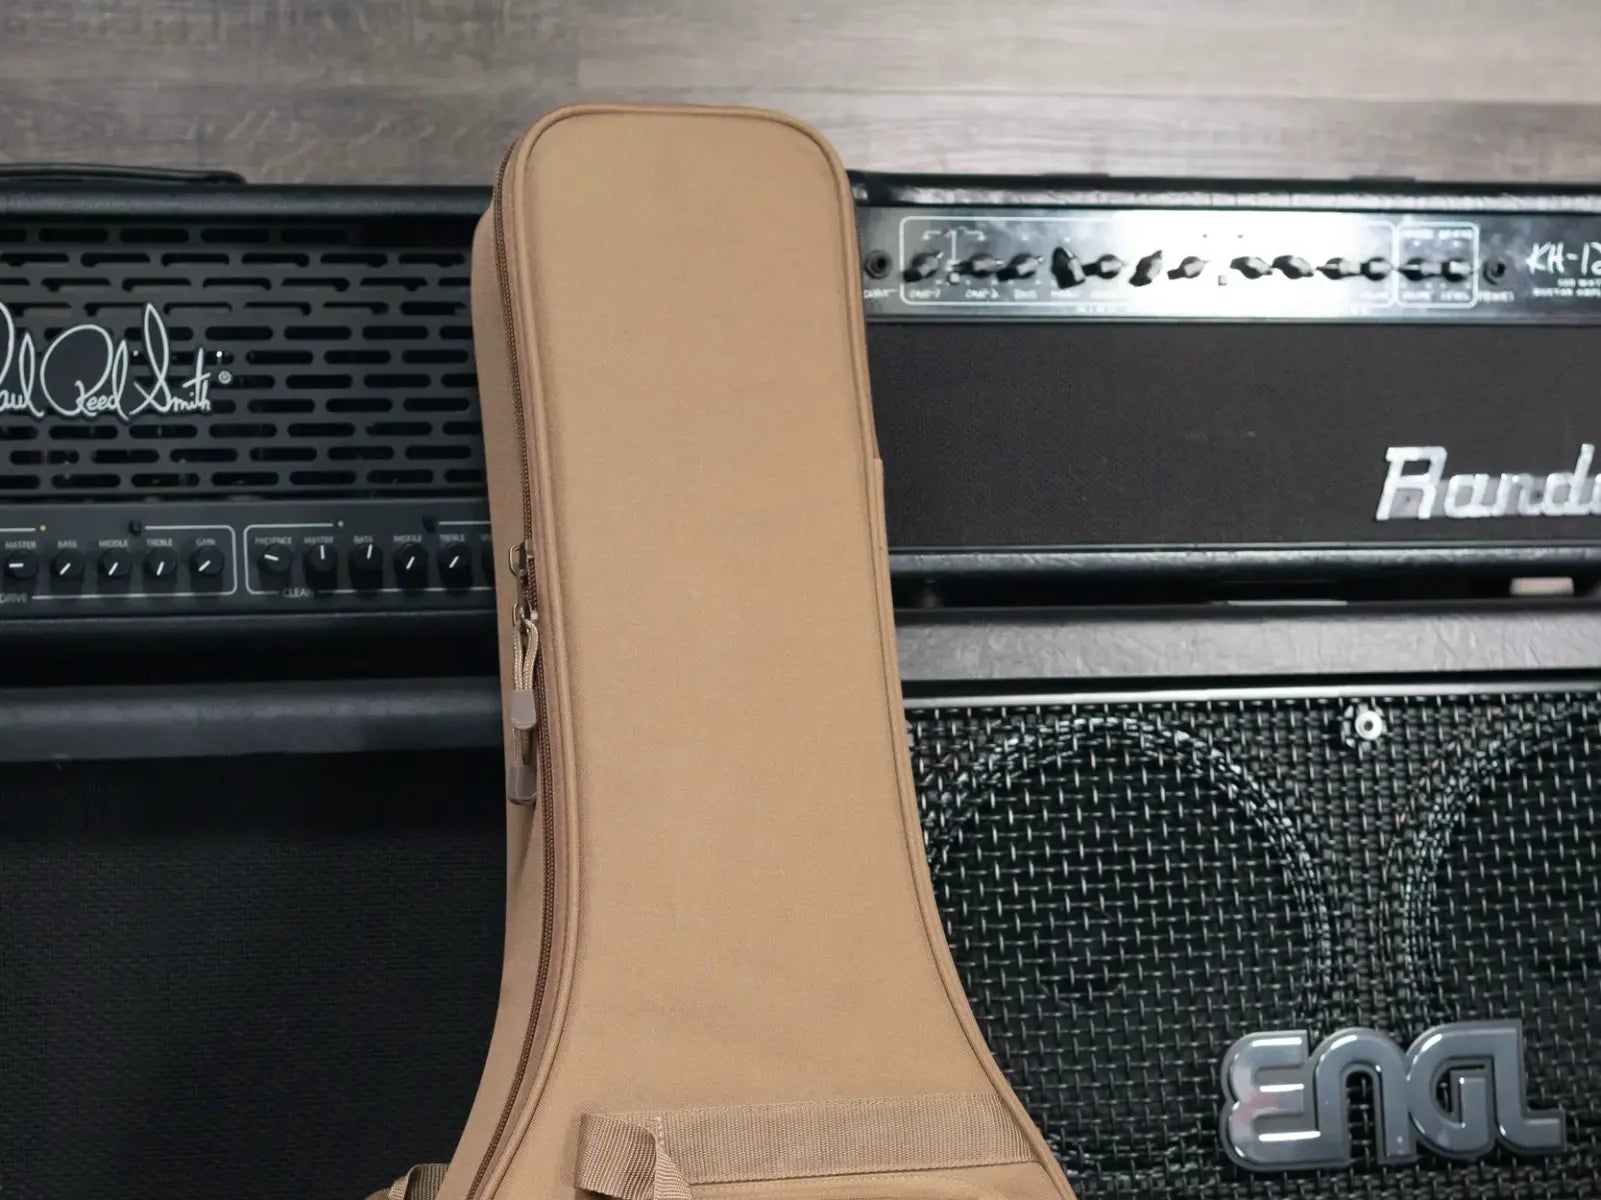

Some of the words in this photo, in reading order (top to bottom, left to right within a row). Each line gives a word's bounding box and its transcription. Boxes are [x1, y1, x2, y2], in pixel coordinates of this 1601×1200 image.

[40, 324, 130, 420] Reed
[129, 303, 212, 414] Smith
[4, 539, 37, 550] MASTER
[1219, 1019, 1567, 1172] ENGL
